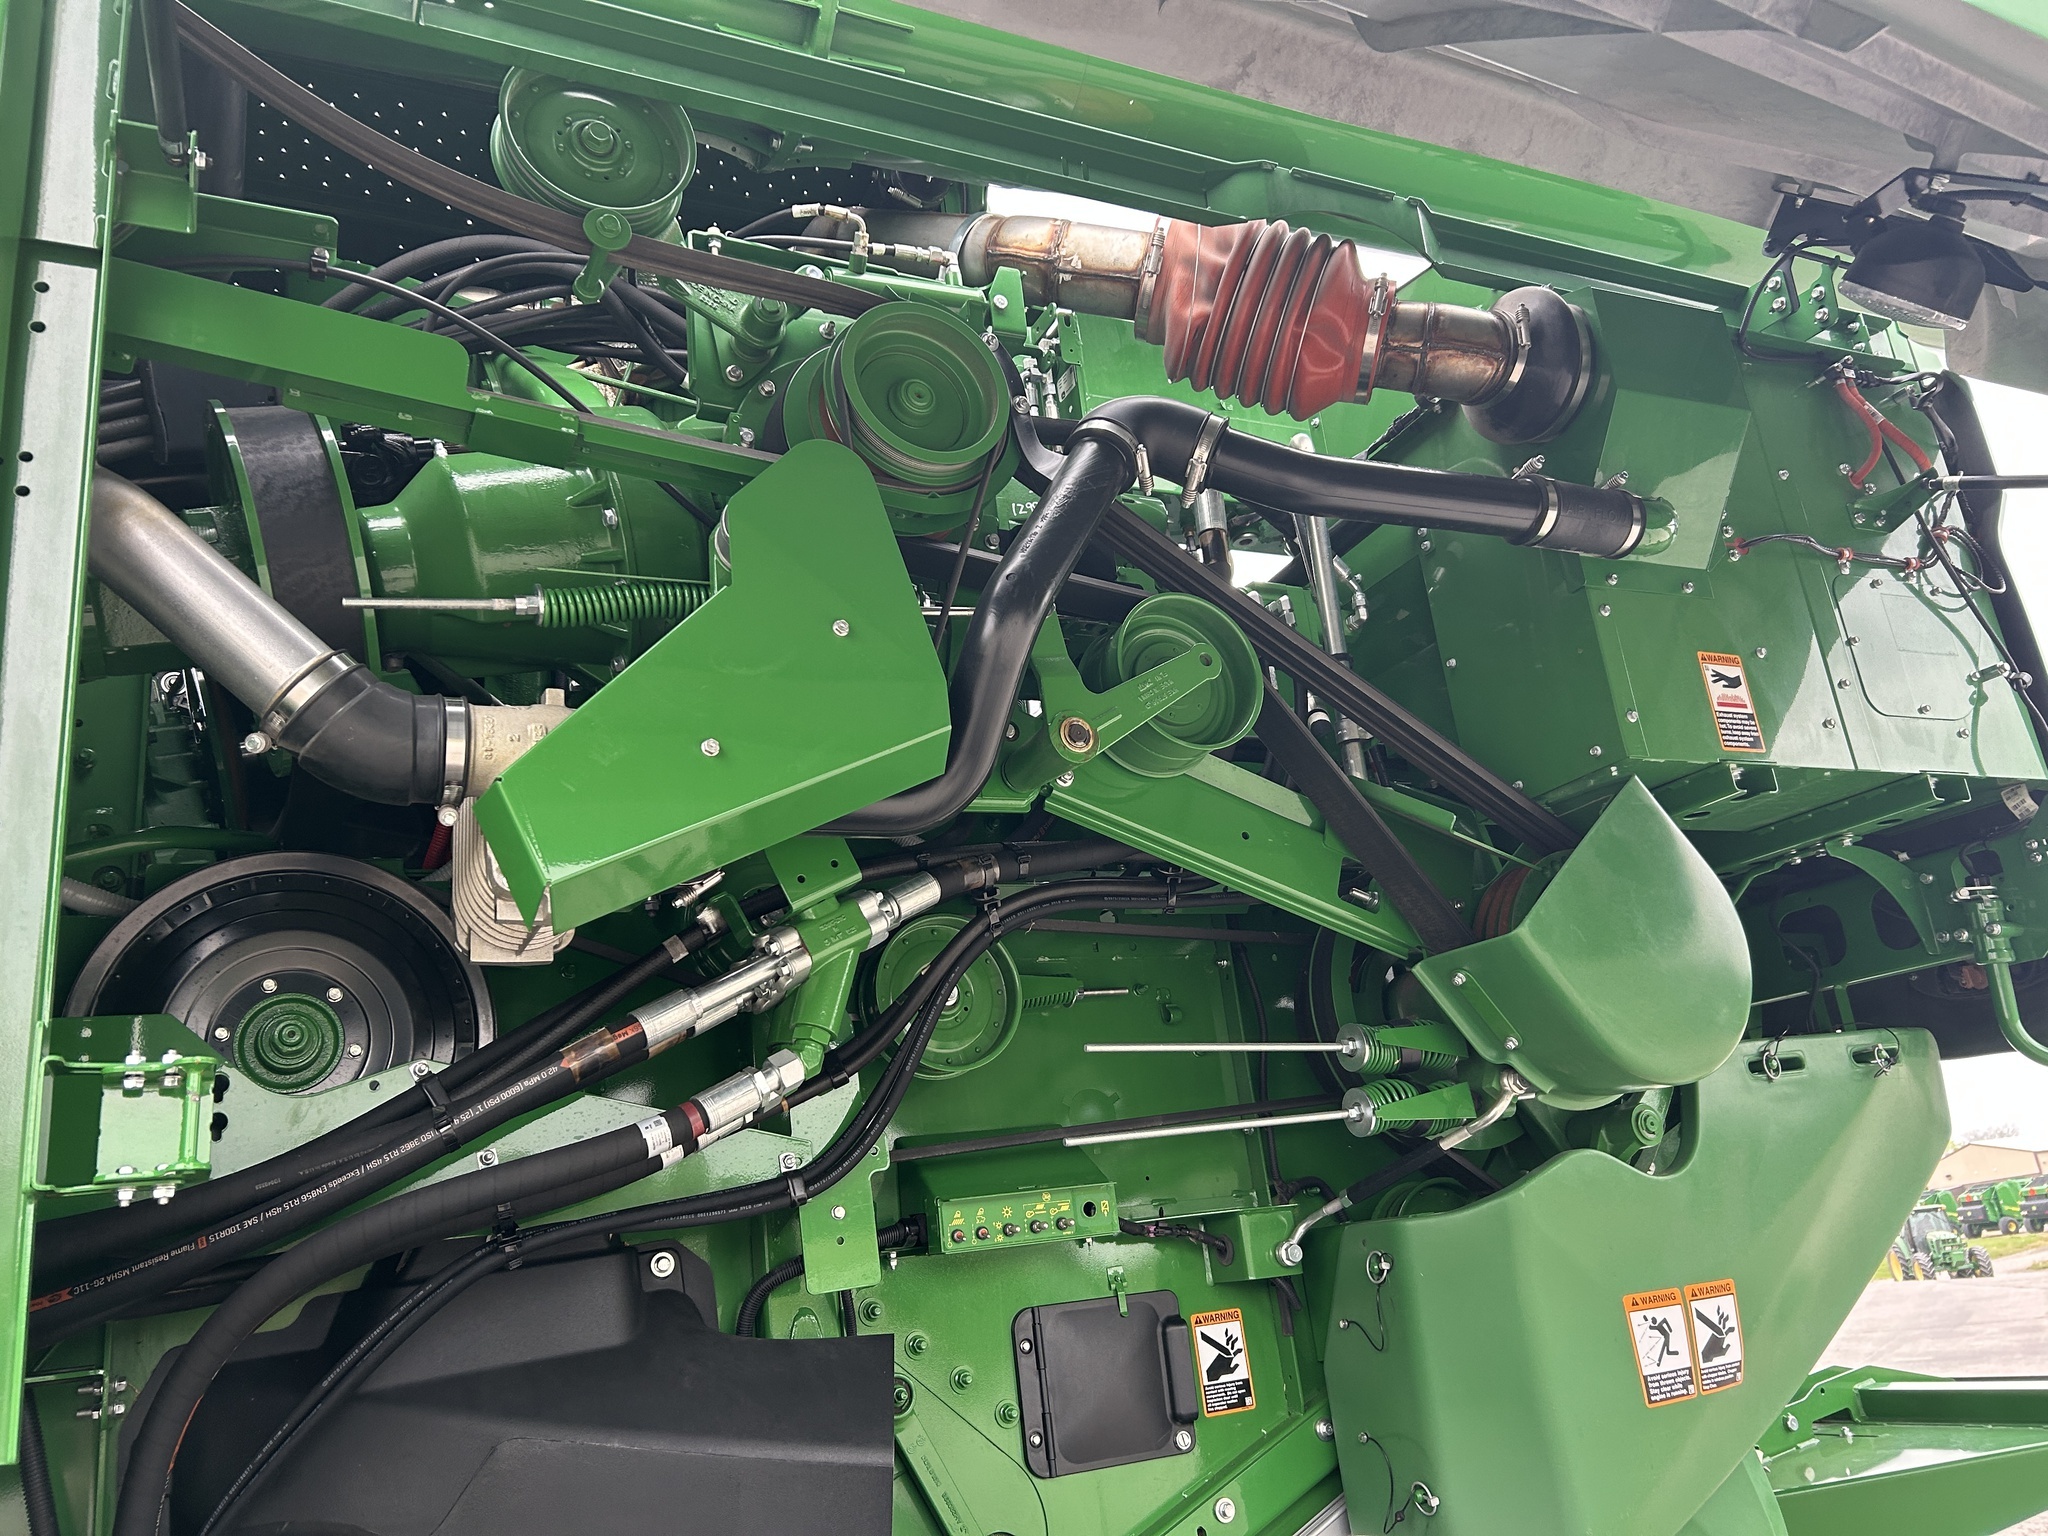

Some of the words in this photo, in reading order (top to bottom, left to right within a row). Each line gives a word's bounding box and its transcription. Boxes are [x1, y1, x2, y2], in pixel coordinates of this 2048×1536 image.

[1706, 654, 1740, 665] WARNING
[539, 1064, 559, 1079] 42.0
[522, 1073, 541, 1088] MPa
[498, 1081, 524, 1100] (6000
[482, 1094, 501, 1109] PSI)
[451, 1107, 474, 1125] (25.4
[419, 1129, 435, 1142] ISO
[398, 1136, 421, 1154] 3862
[381, 1147, 400, 1162] R15
[364, 1155, 384, 1171] 4SH
[326, 1166, 361, 1190] Exceeds
[299, 1182, 328, 1203] EN856
[281, 1196, 301, 1210] R15
[264, 1204, 283, 1218] 4SH
[241, 1215, 259, 1229] SAE
[207, 1222, 242, 1243] 100R15
[168, 1240, 196, 1258] Flame
[129, 1250, 170, 1273] Resistant
[104, 1266, 130, 1282] MSHA
[71, 1275, 106, 1296] 2G-11C
[1696, 1282, 1731, 1296] WARNING
[1640, 1292, 1677, 1306] WARNING
[1202, 1310, 1240, 1324] WARNING
